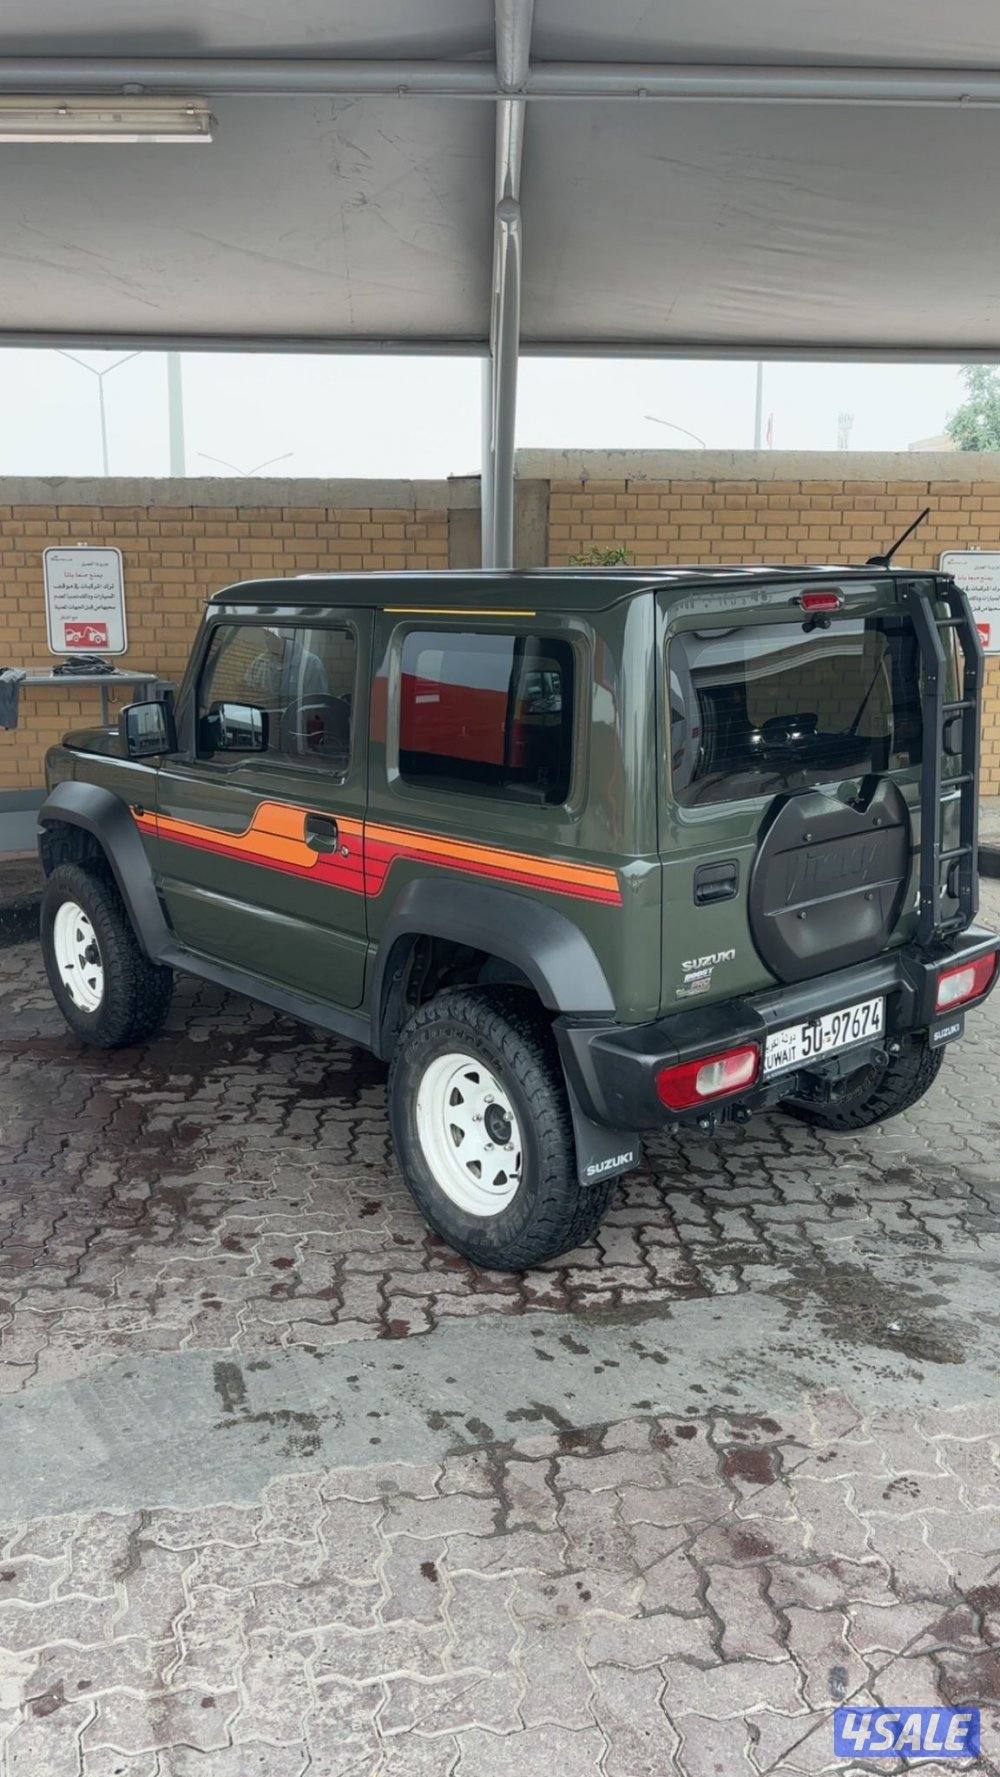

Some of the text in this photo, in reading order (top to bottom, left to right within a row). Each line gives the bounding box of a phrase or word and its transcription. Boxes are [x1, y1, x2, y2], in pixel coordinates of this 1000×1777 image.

[681, 949, 736, 972] SUZUKI
[933, 1023, 960, 1041] SUZUKI
[764, 1046, 796, 1071] UWAIT
[586, 1151, 633, 1177] SUZUKI
